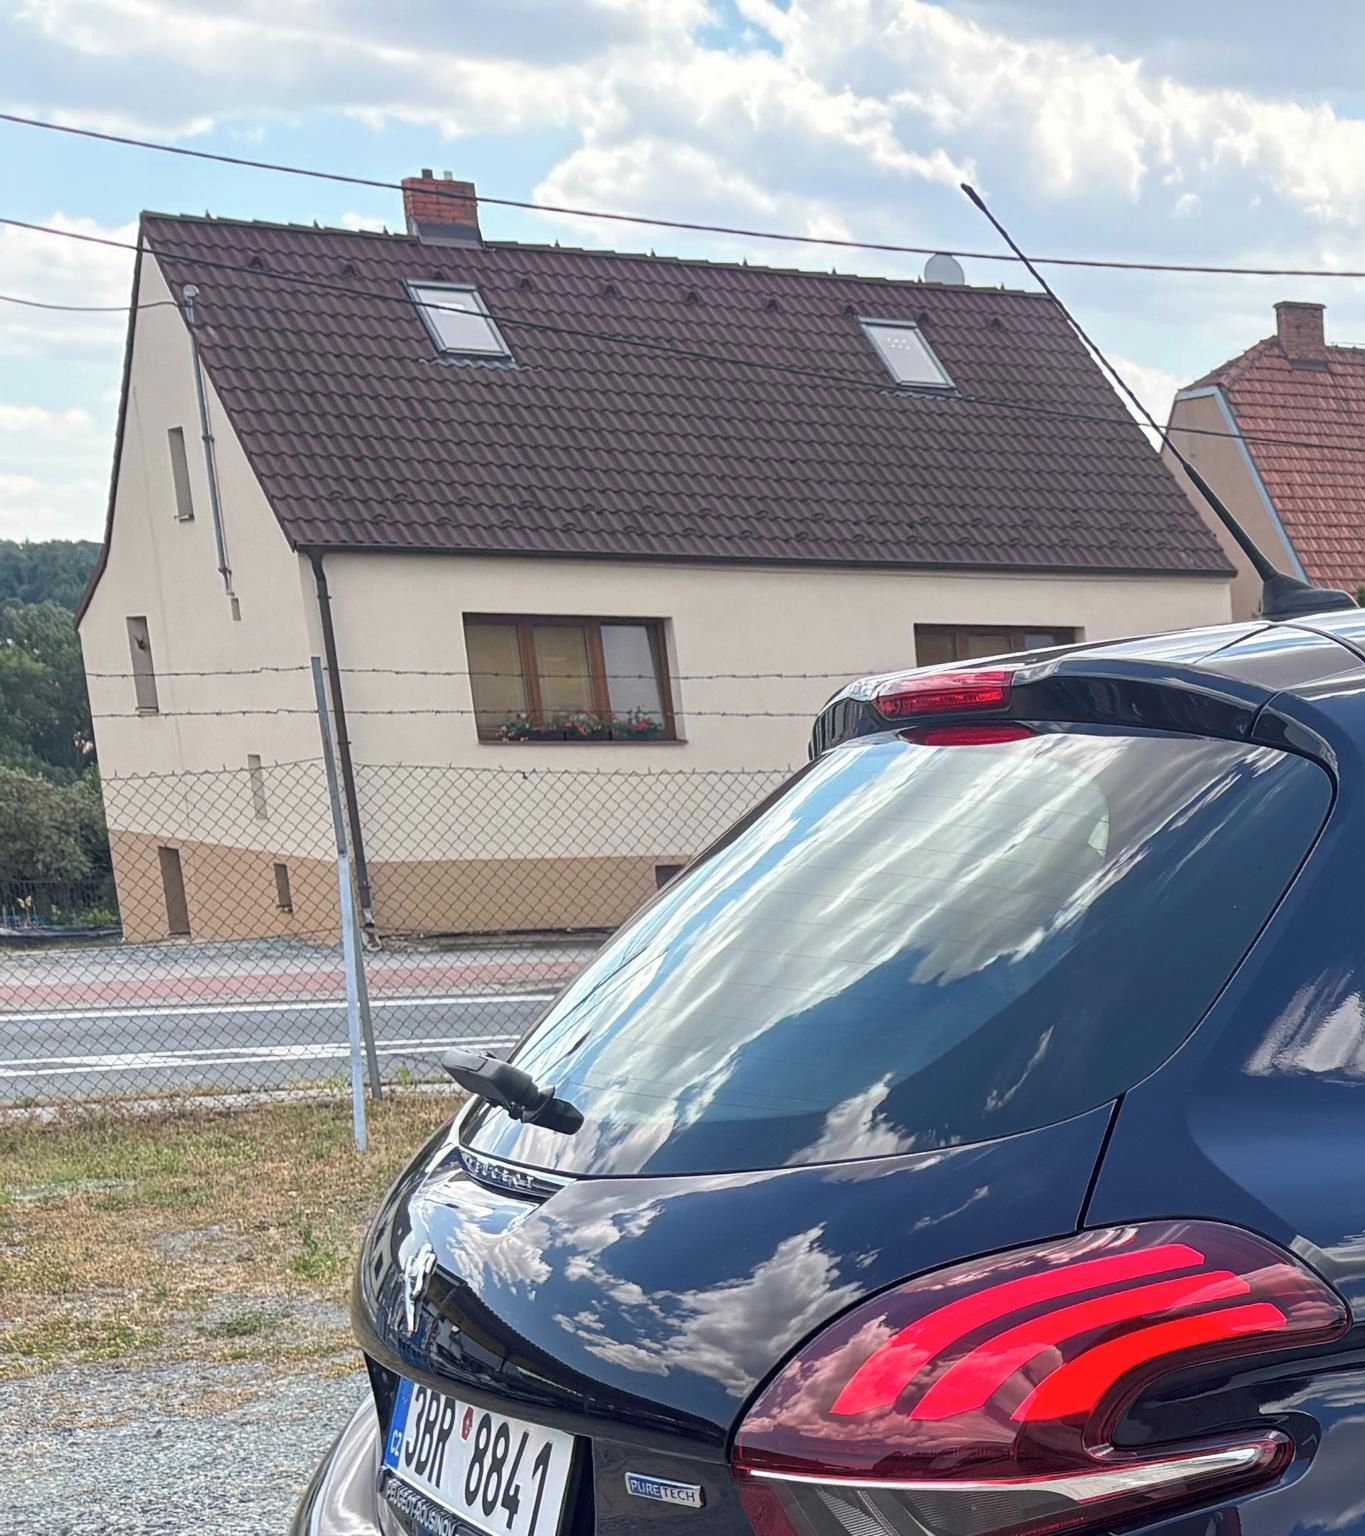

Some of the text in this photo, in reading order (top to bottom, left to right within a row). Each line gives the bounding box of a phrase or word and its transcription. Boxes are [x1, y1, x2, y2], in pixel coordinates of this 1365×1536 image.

[390, 1430, 403, 1456] CZ
[404, 1385, 456, 1489] 3BR
[630, 1479, 696, 1503] PURETECH
